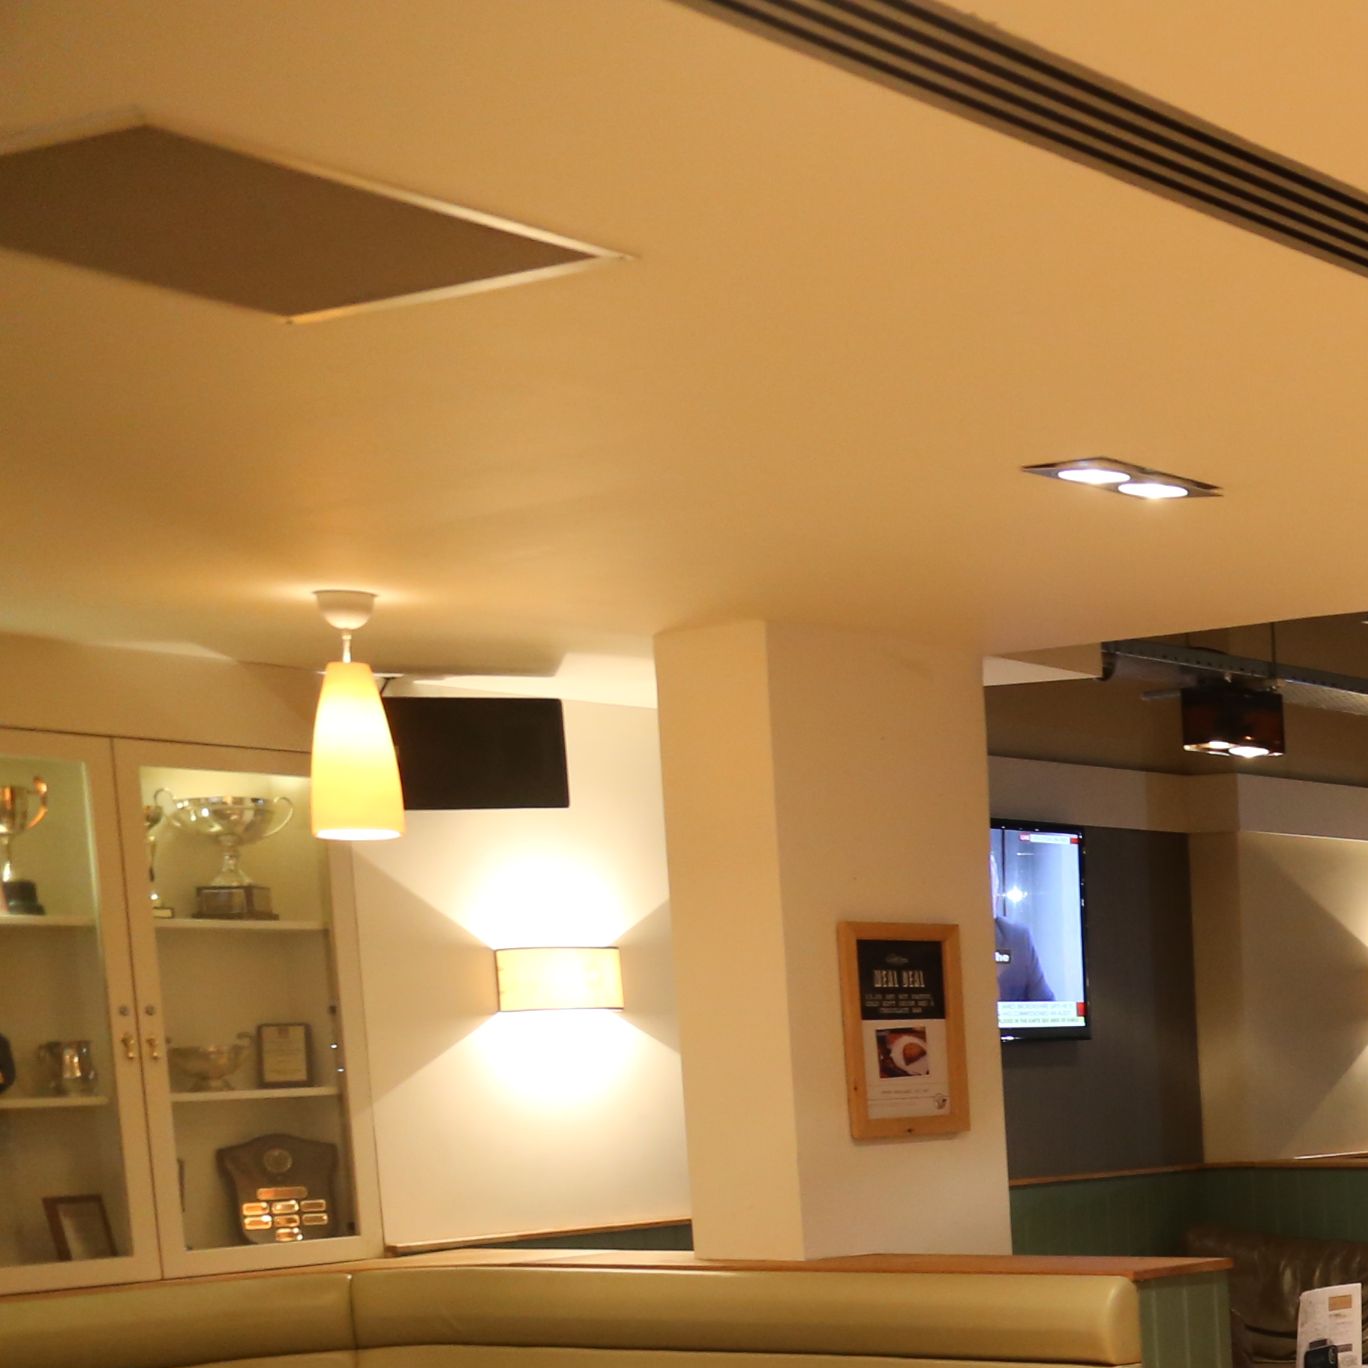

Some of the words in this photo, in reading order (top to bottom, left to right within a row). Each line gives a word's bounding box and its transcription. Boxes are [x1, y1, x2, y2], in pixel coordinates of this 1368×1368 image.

[995, 950, 1010, 962] he
[874, 970, 899, 988] MEAL
[902, 970, 926, 988] DEAL
